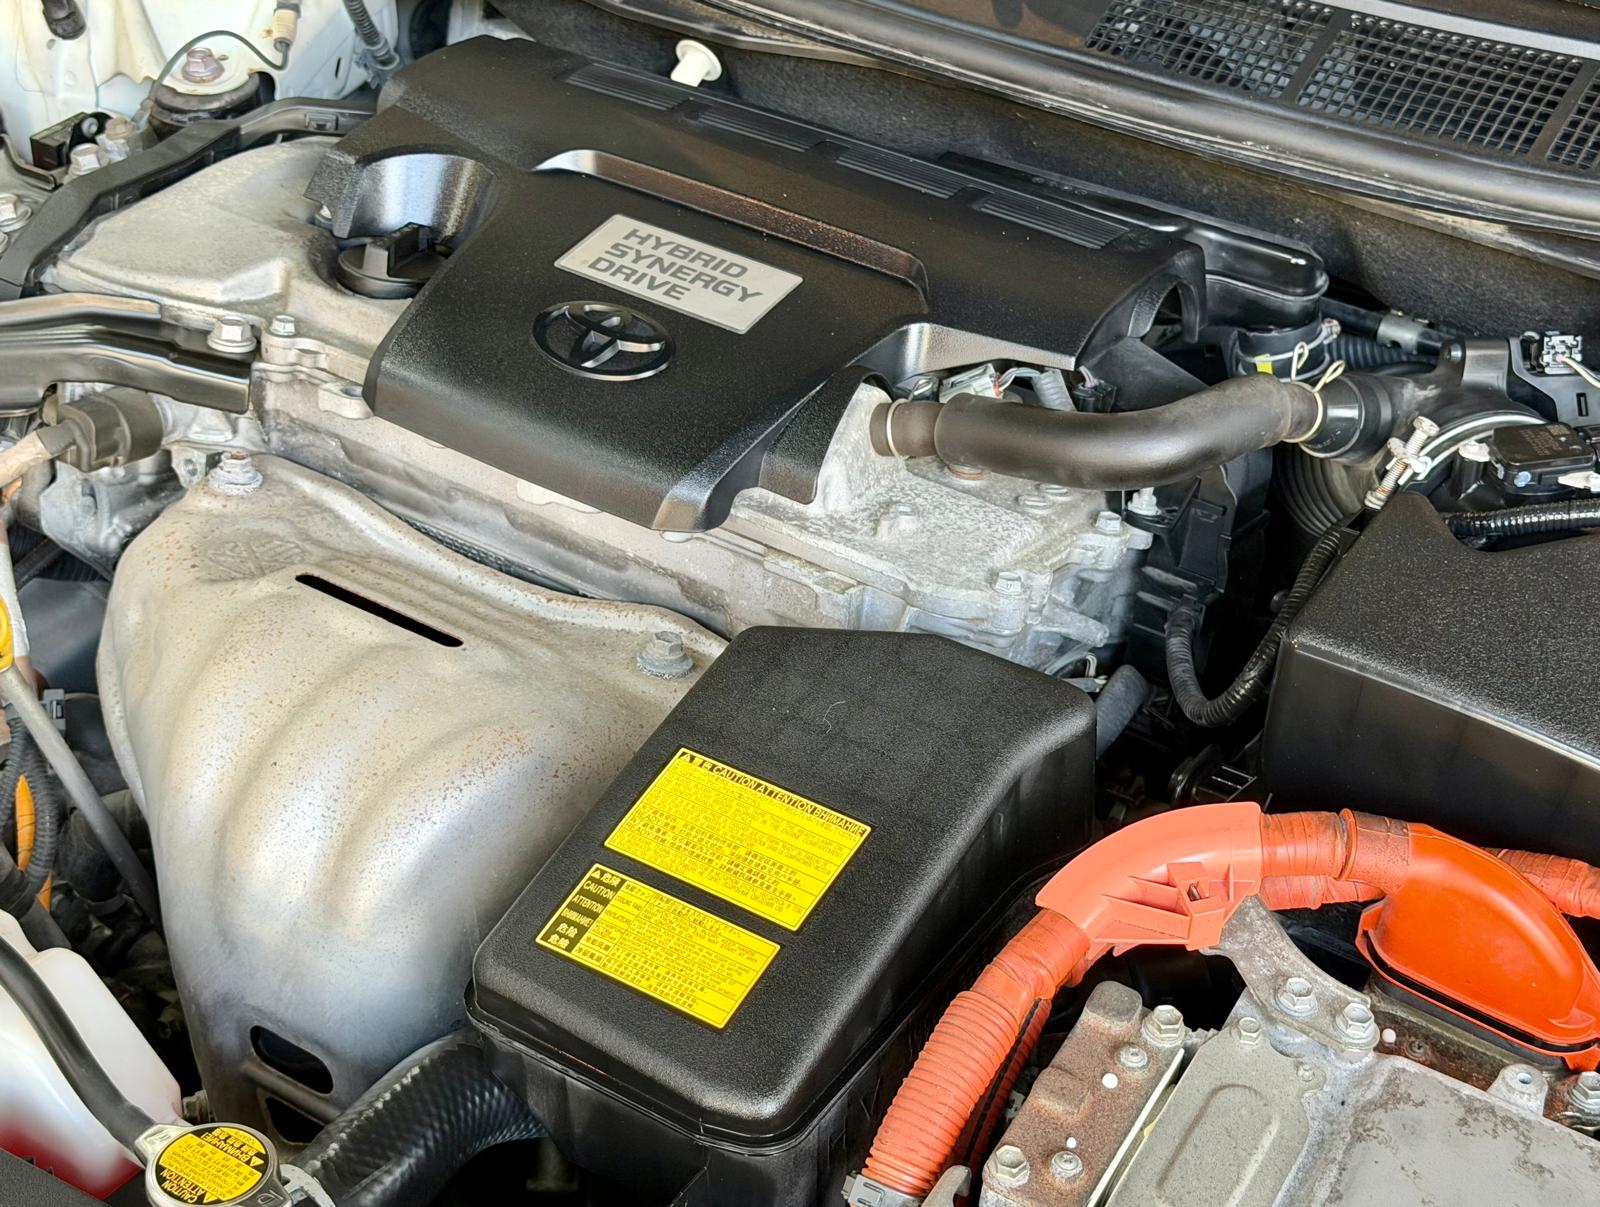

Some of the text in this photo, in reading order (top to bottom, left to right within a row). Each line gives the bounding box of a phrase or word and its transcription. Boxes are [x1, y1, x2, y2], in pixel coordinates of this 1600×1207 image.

[624, 228, 748, 279] HYBRID
[588, 256, 692, 301] DRIVE
[605, 242, 763, 303] SYNERGY
[711, 765, 757, 789] CAUTION
[755, 784, 814, 813] ATTENTION
[571, 893, 604, 914] ATTENTION
[582, 879, 615, 899] CAUTION
[159, 1168, 205, 1196] ATTENTION
[160, 1180, 197, 1203] CAUTION
